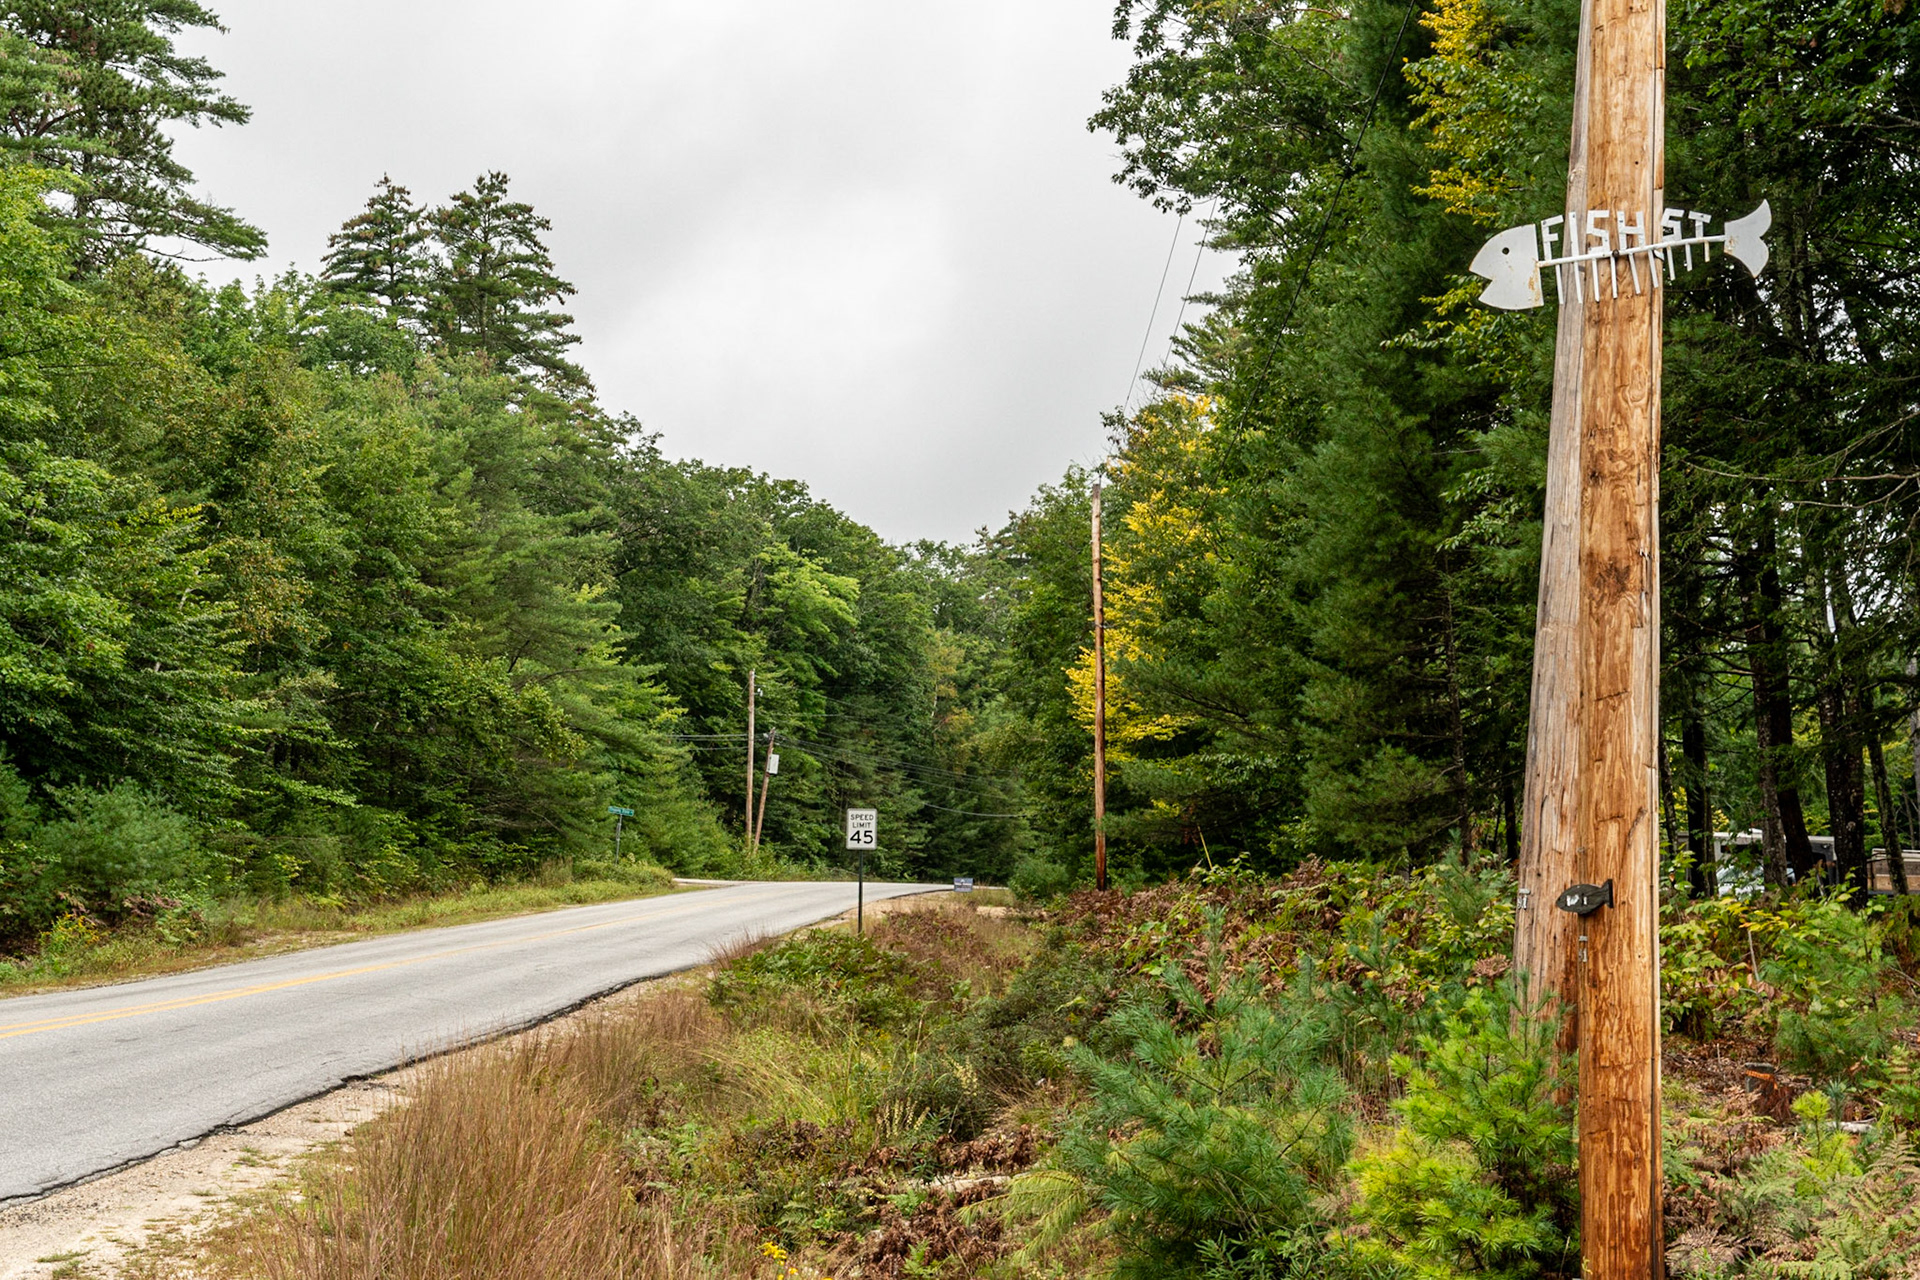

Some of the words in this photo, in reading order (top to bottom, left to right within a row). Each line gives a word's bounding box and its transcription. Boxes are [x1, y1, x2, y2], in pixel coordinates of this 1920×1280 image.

[1541, 209, 1646, 259] FISH
[1660, 207, 1712, 244] ST
[850, 813, 874, 821] SPEED
[850, 830, 873, 844] 45
